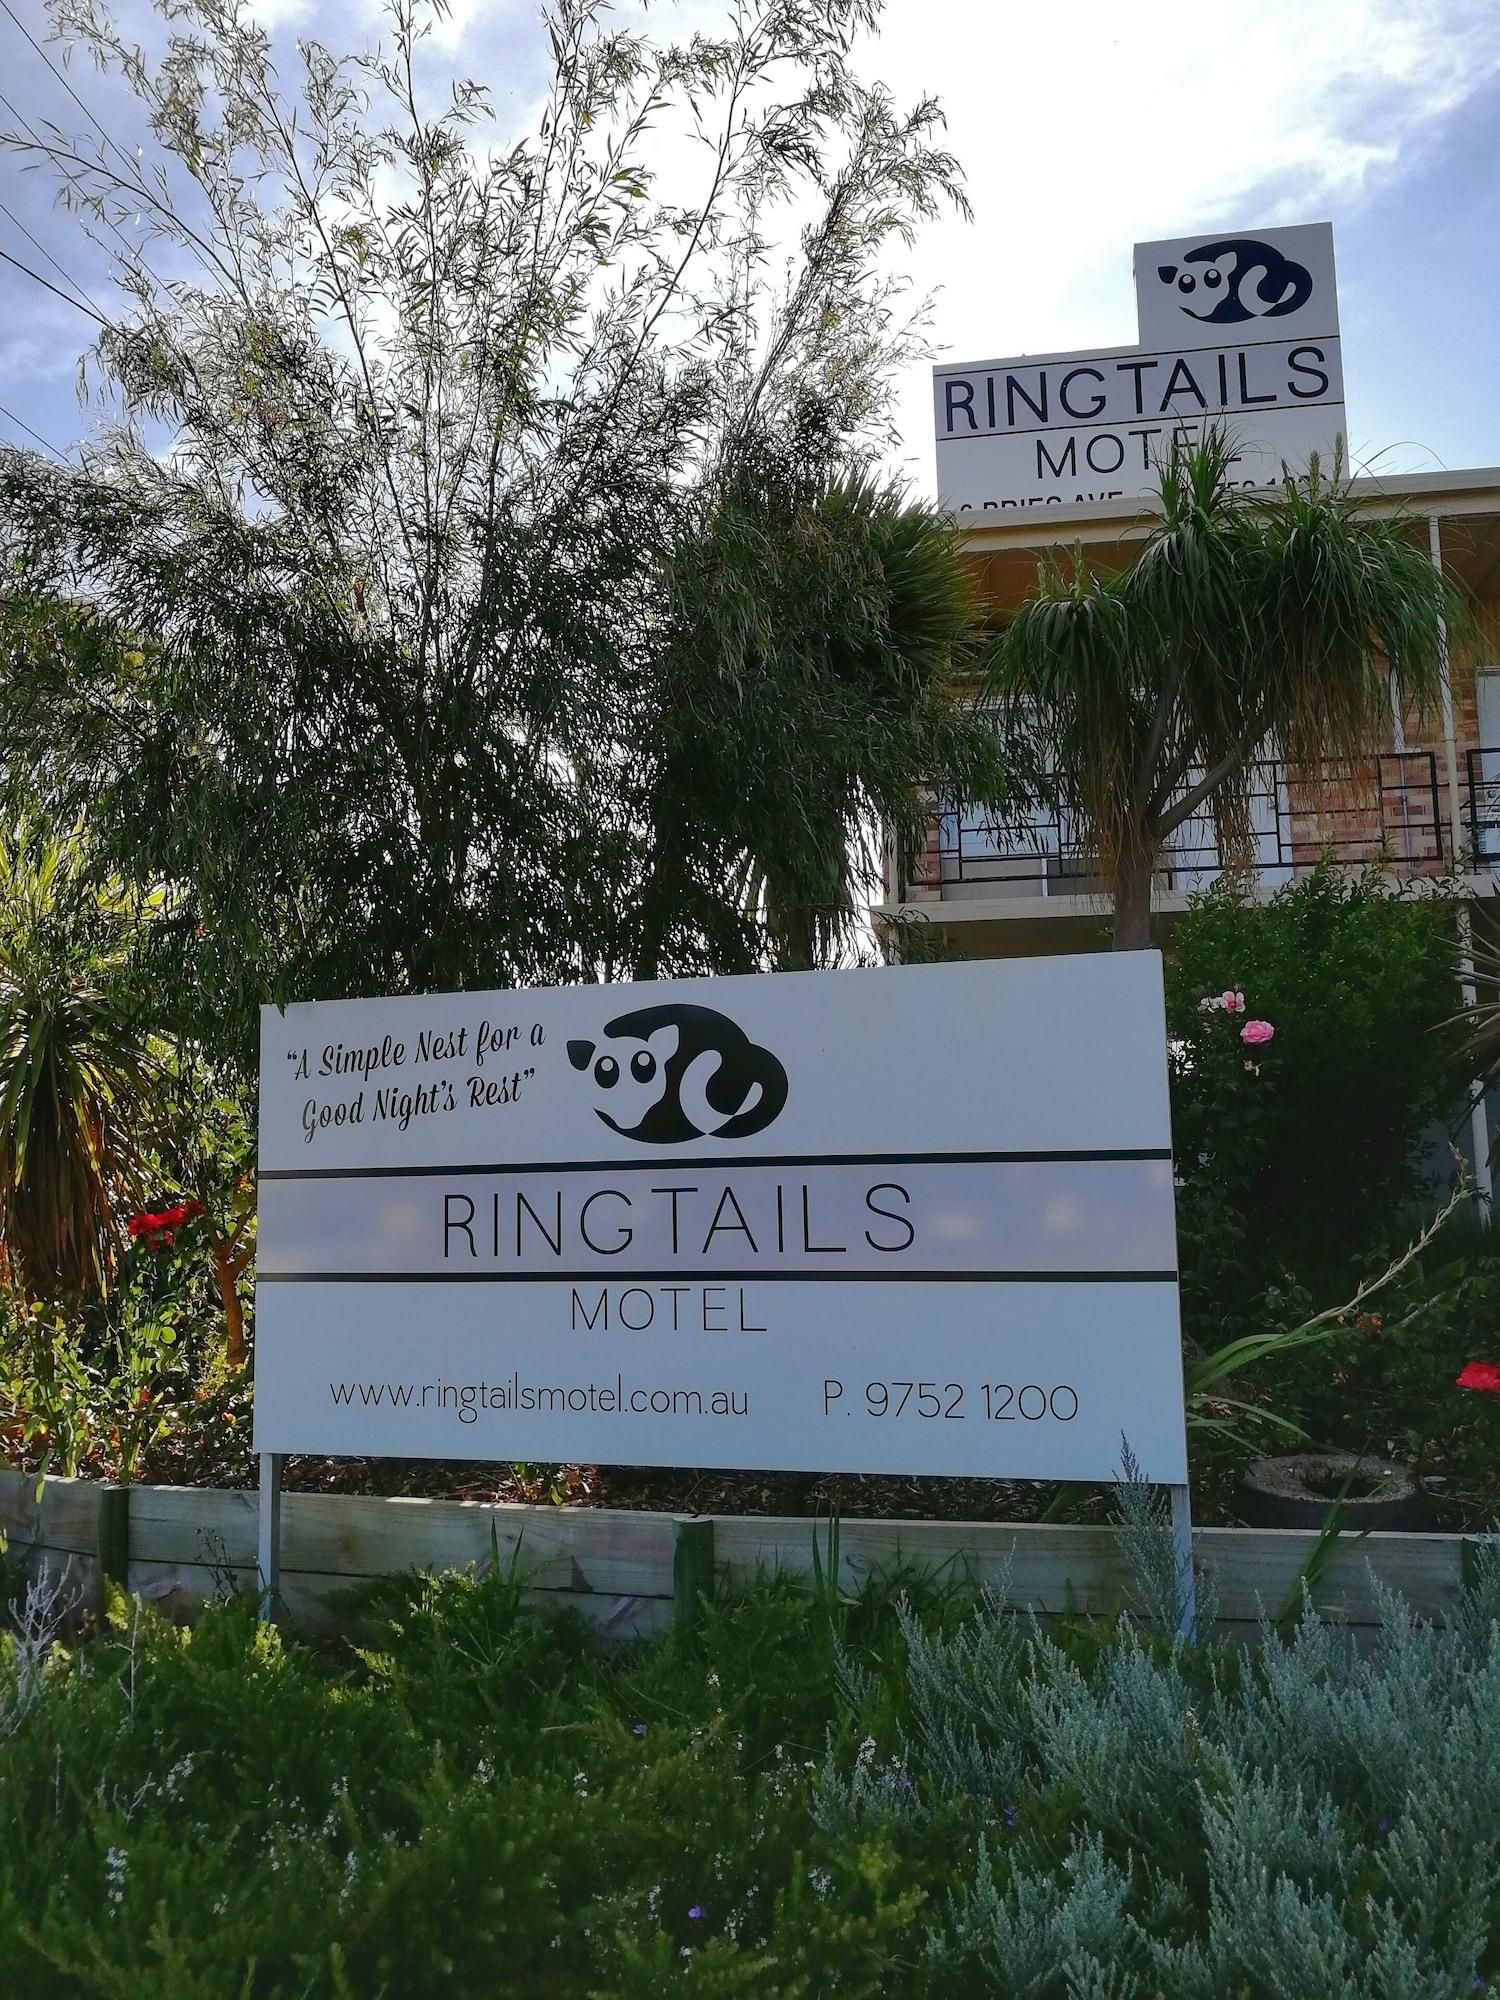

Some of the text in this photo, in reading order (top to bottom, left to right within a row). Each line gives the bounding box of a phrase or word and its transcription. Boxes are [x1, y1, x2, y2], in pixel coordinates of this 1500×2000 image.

[945, 346, 1329, 432] RINGTAILS
[318, 1034, 407, 1082] Simple
[415, 1027, 468, 1064] Nest
[476, 1020, 522, 1067] for
[530, 1023, 546, 1047] a
[302, 1092, 365, 1144] Good
[443, 1183, 916, 1258] RINGTAILS
[571, 1288, 767, 1332] MOTEL
[331, 1372, 748, 1423] www.ringtailsmotel.com.au
[824, 1380, 1079, 1421] P. 9752 1200
